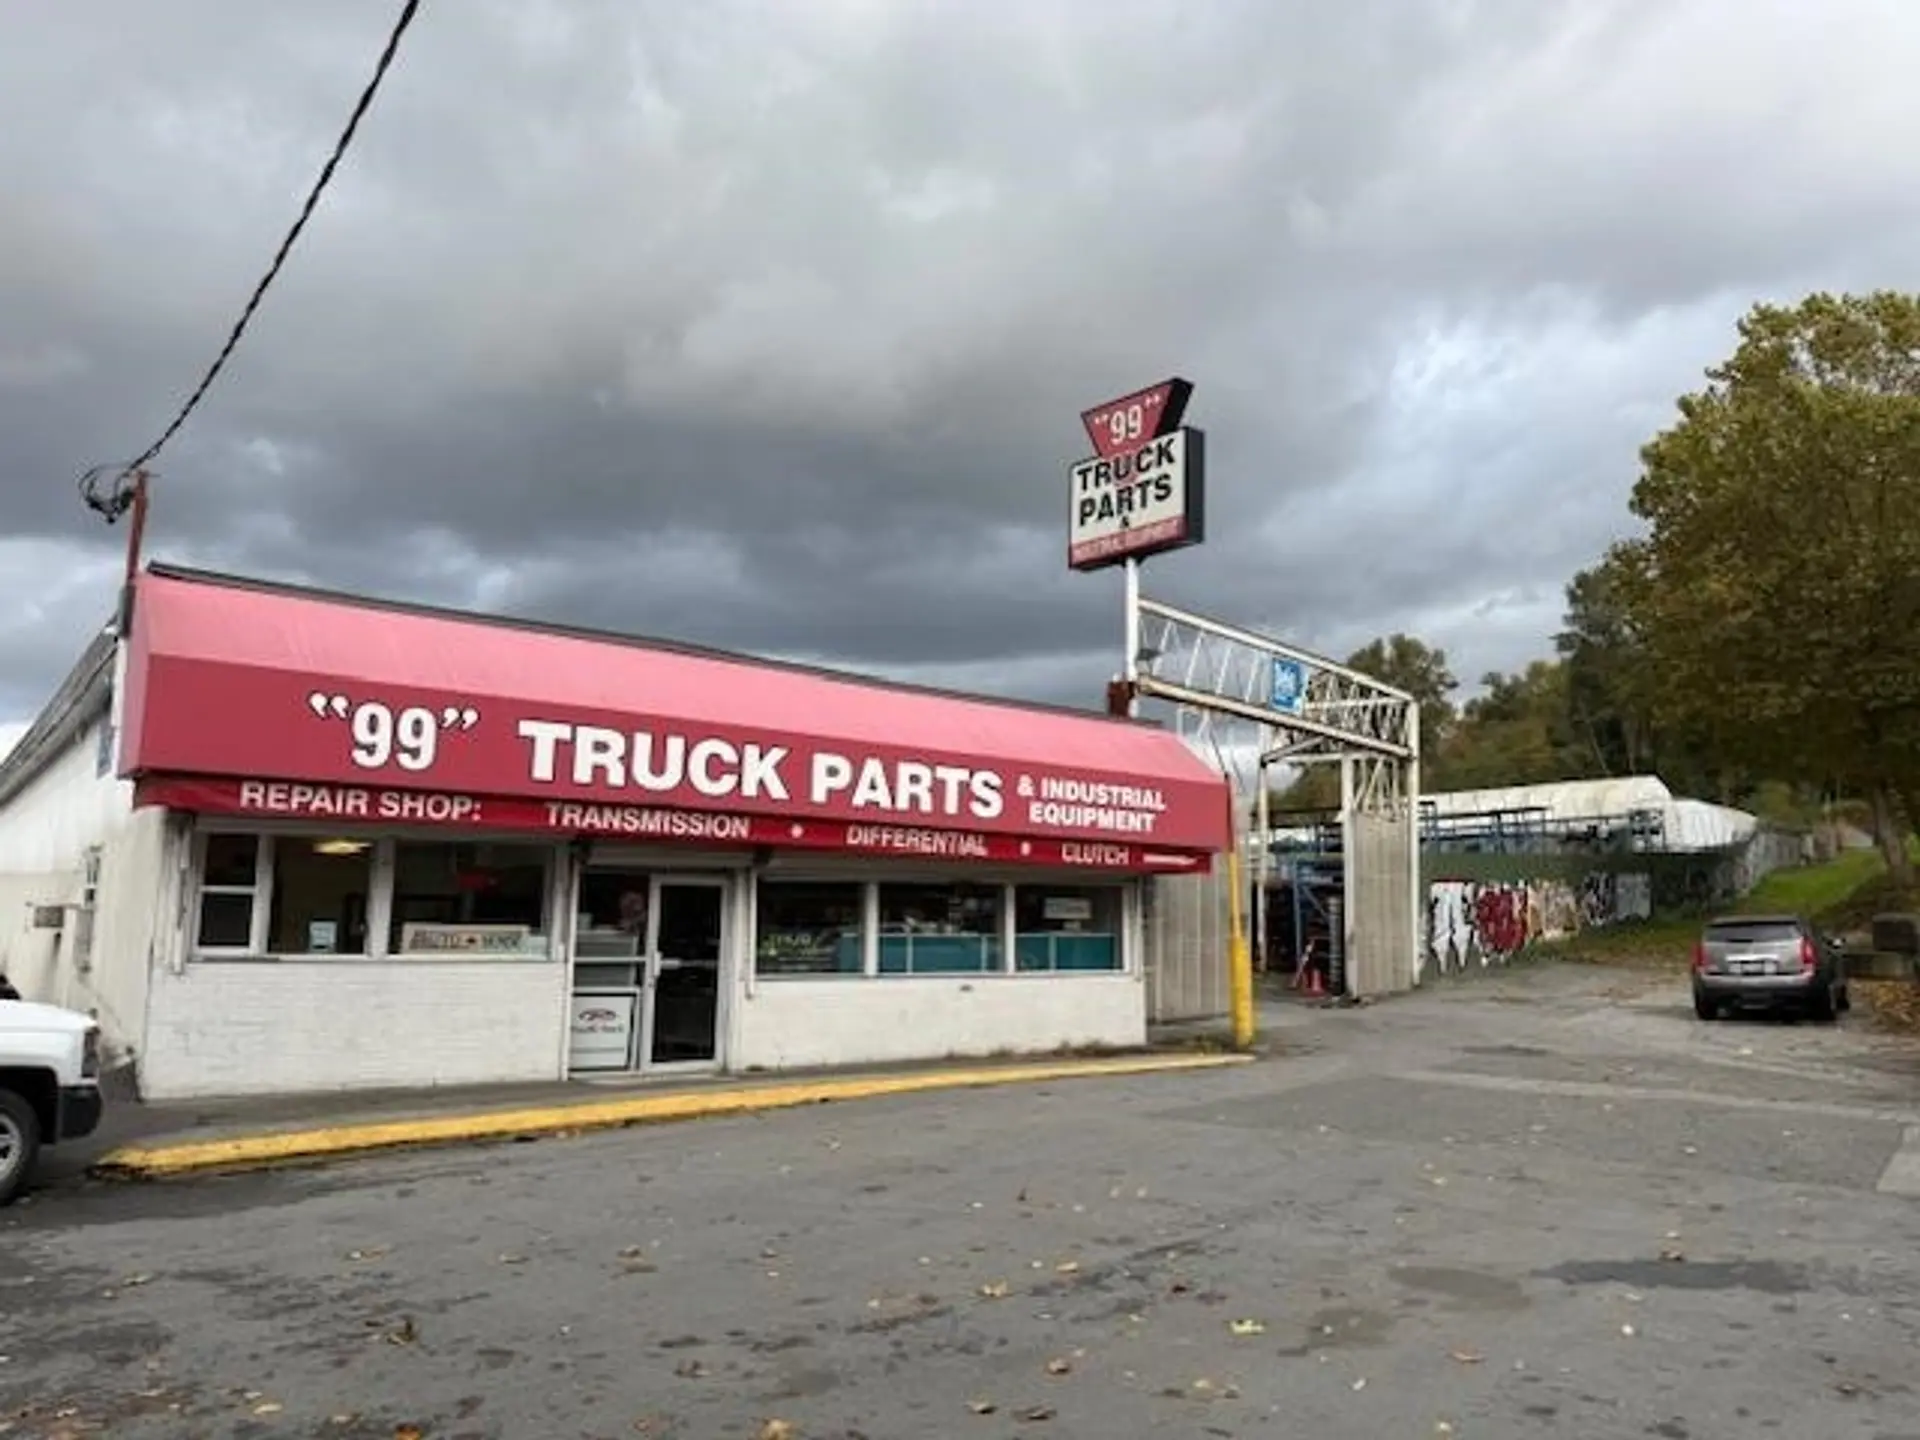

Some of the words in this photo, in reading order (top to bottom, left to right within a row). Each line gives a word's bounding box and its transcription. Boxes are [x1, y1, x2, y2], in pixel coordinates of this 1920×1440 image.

[1077, 438, 1175, 490] TRUCK
[1080, 473, 1172, 527] PARTS
[310, 692, 478, 771] "99"
[518, 719, 791, 802] TRUCK
[810, 752, 1003, 818] PARTS
[1016, 774, 1035, 796] &
[1041, 777, 1167, 811] INDUSTRIAL
[1029, 802, 1156, 832] EQUIPMENT
[239, 780, 369, 815] REPAIR
[378, 791, 482, 821] SHOP:
[546, 801, 751, 839] TRANSMISSION
[846, 825, 989, 857] DIFFERENTIAL
[1061, 843, 1130, 865] CLUTCH
